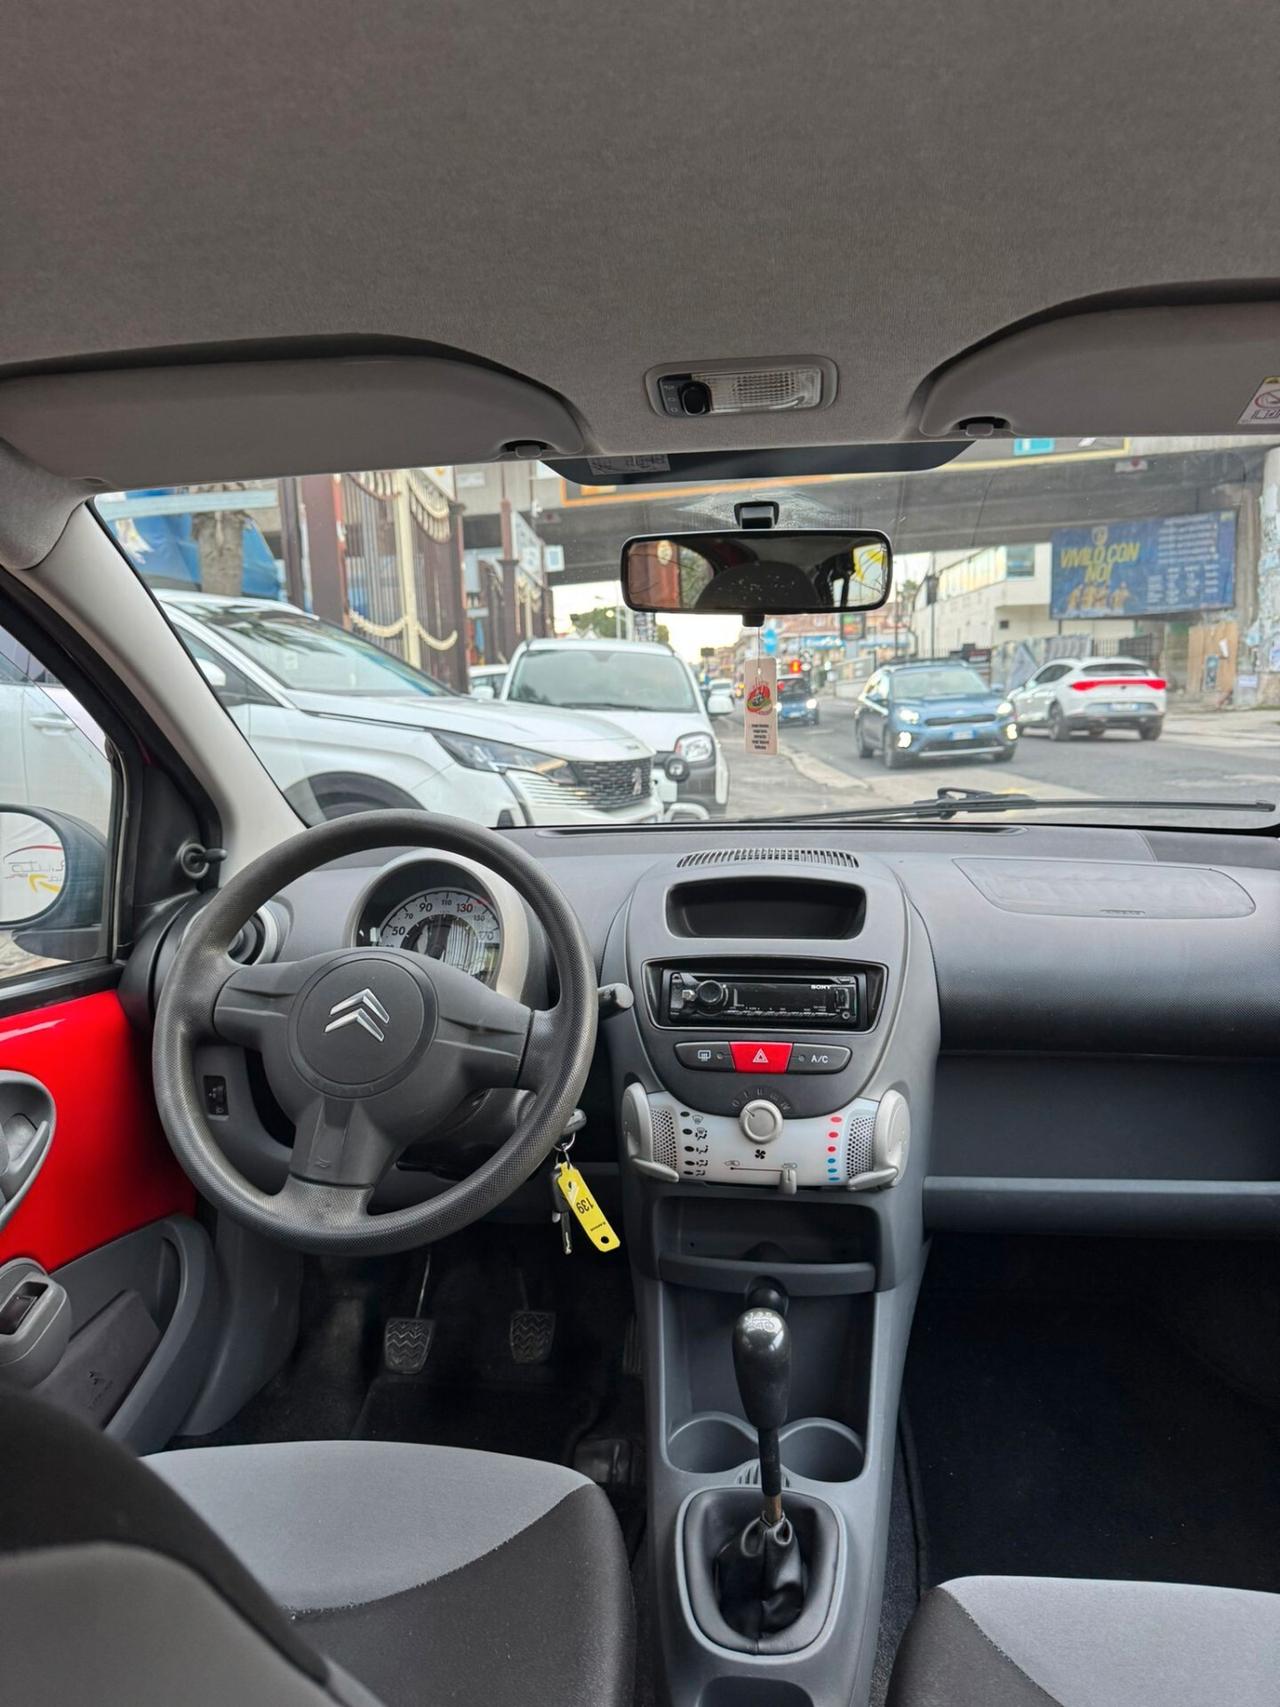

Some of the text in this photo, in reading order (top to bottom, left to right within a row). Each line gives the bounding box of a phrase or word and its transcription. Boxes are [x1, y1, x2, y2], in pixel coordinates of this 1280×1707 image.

[1106, 543, 1140, 563] CON
[419, 902, 433, 912] 90
[456, 903, 473, 913] 130
[391, 926, 406, 936] 50
[810, 1054, 829, 1064] A/C
[575, 1197, 594, 1214] 139
